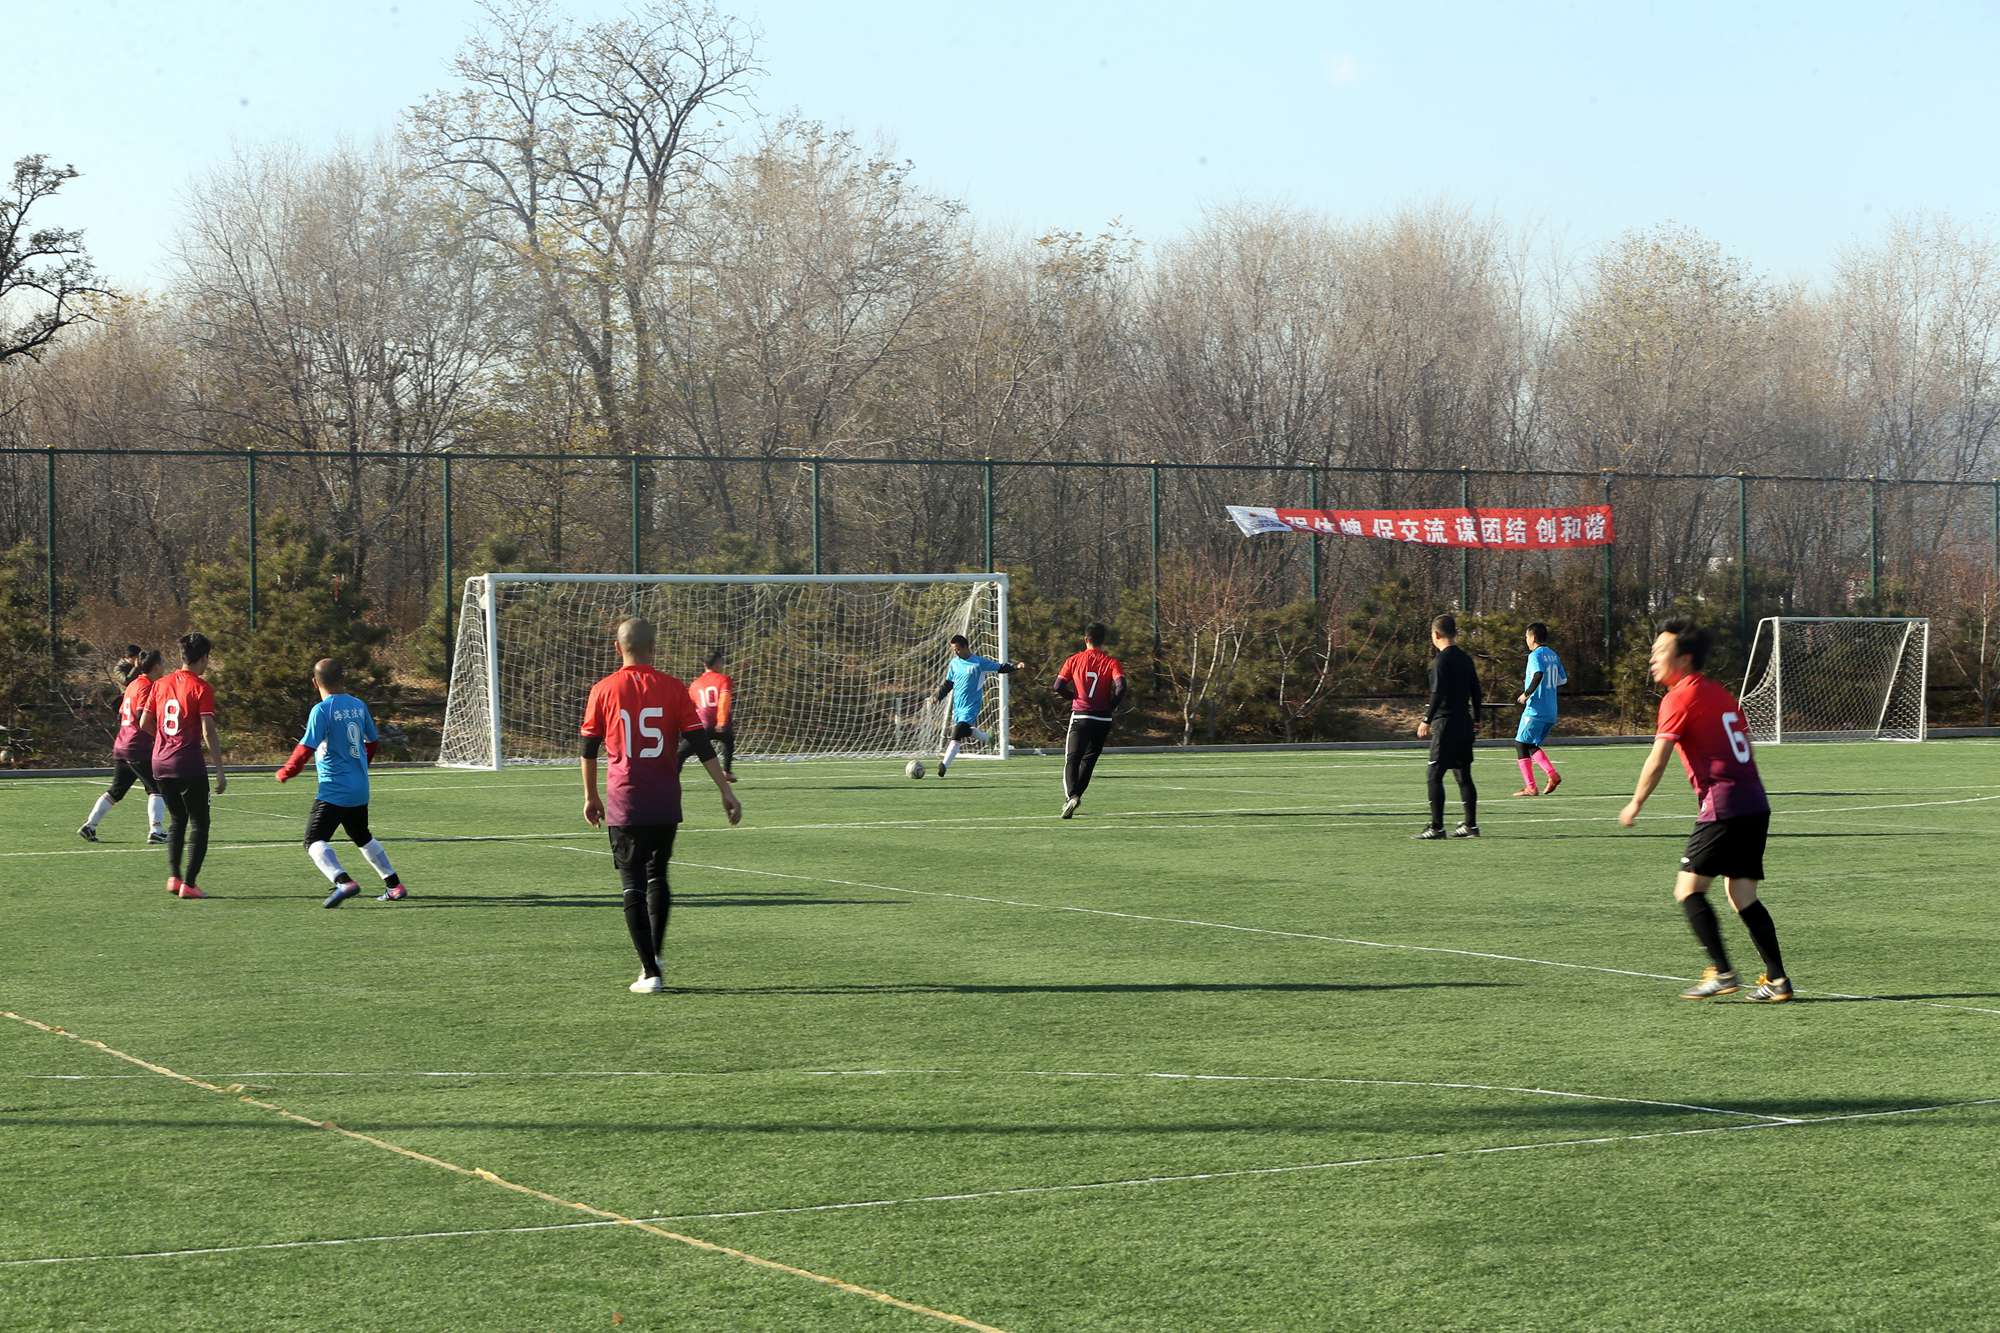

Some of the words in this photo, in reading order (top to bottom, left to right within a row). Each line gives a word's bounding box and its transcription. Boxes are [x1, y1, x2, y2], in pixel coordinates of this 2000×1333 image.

[1373, 517, 1448, 544] 促交流
[1454, 516, 1527, 544] 谋团结
[1536, 513, 1606, 543] 创和谐
[1086, 672, 1098, 698] 7
[1545, 663, 1558, 689] 10
[698, 686, 718, 707] 10
[164, 699, 180, 736] 8
[620, 707, 664, 758] 15
[347, 721, 360, 759] 9
[1722, 711, 1750, 764] 6
